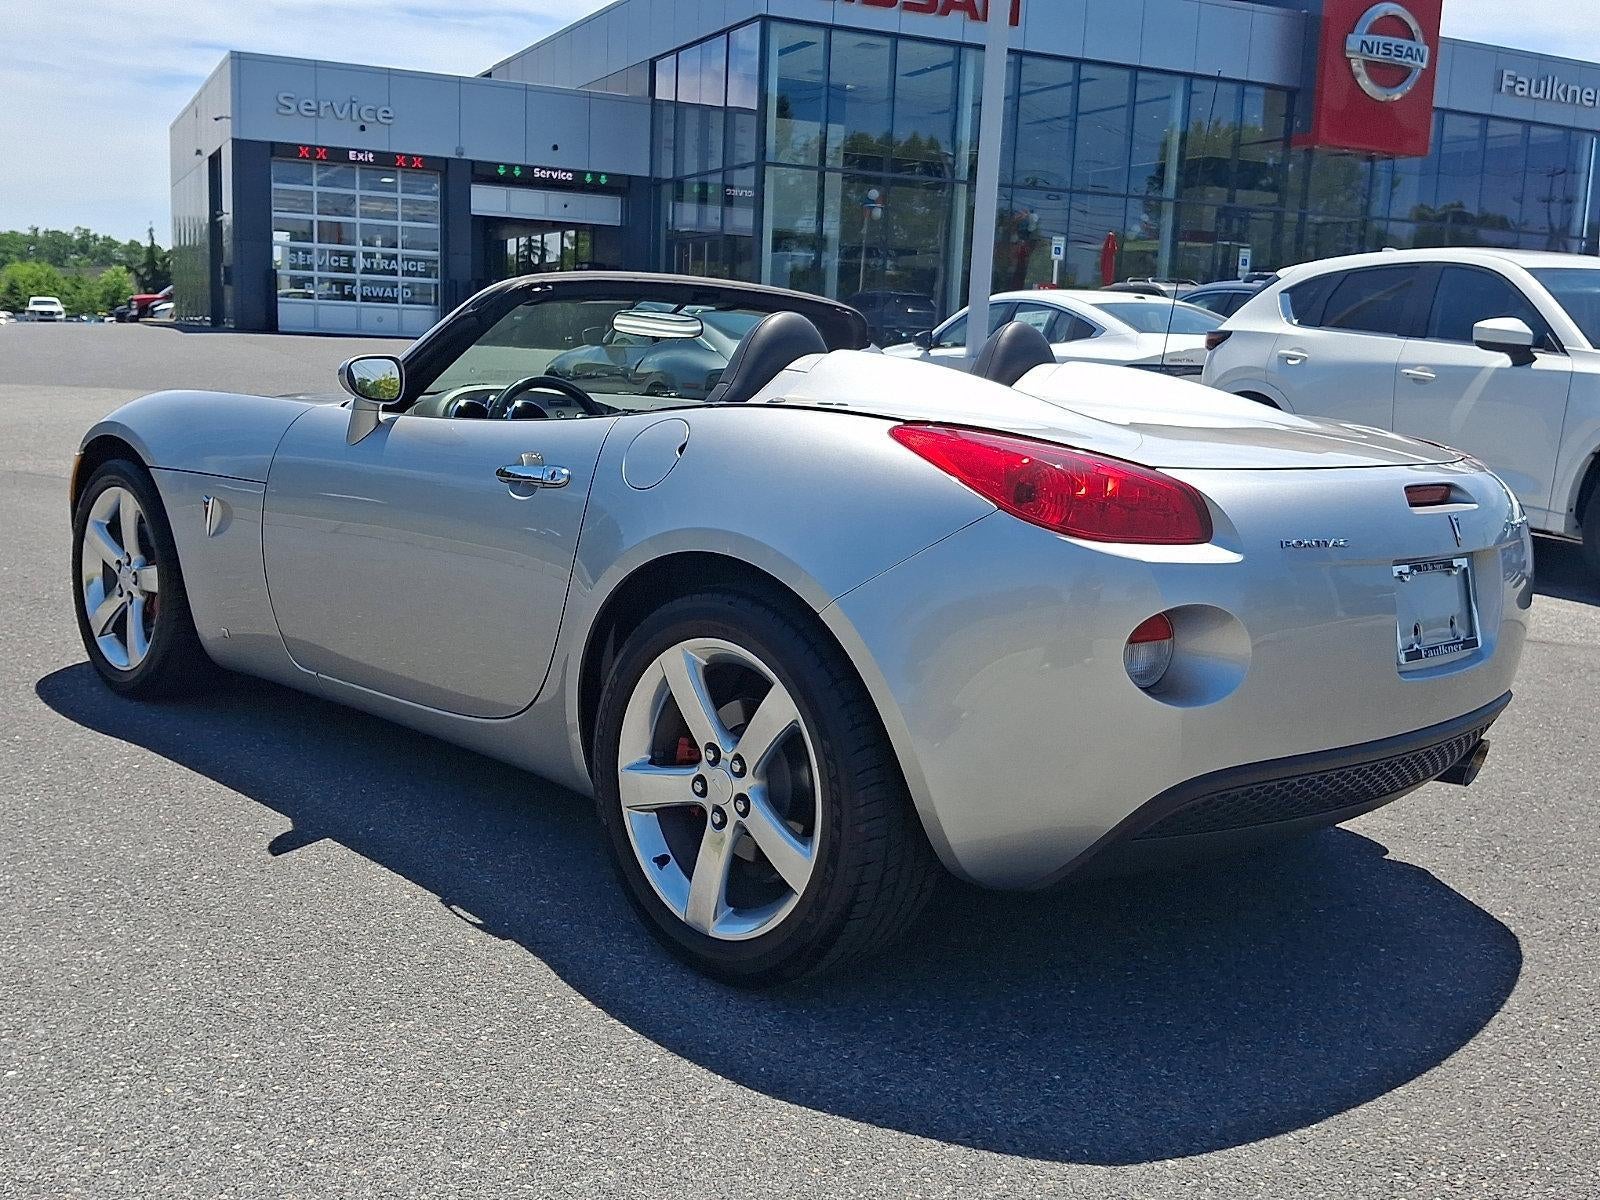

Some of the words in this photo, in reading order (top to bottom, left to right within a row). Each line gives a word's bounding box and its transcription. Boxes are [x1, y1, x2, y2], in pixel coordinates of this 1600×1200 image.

[1360, 39, 1424, 63] NISSAN
[277, 92, 394, 125] Service
[348, 150, 374, 162] Exit
[533, 167, 574, 181] Service
[289, 253, 348, 267] SERVICE
[304, 282, 340, 295] PL
[1280, 538, 1350, 549] PONTIAC
[1421, 642, 1464, 659] Faulkner
